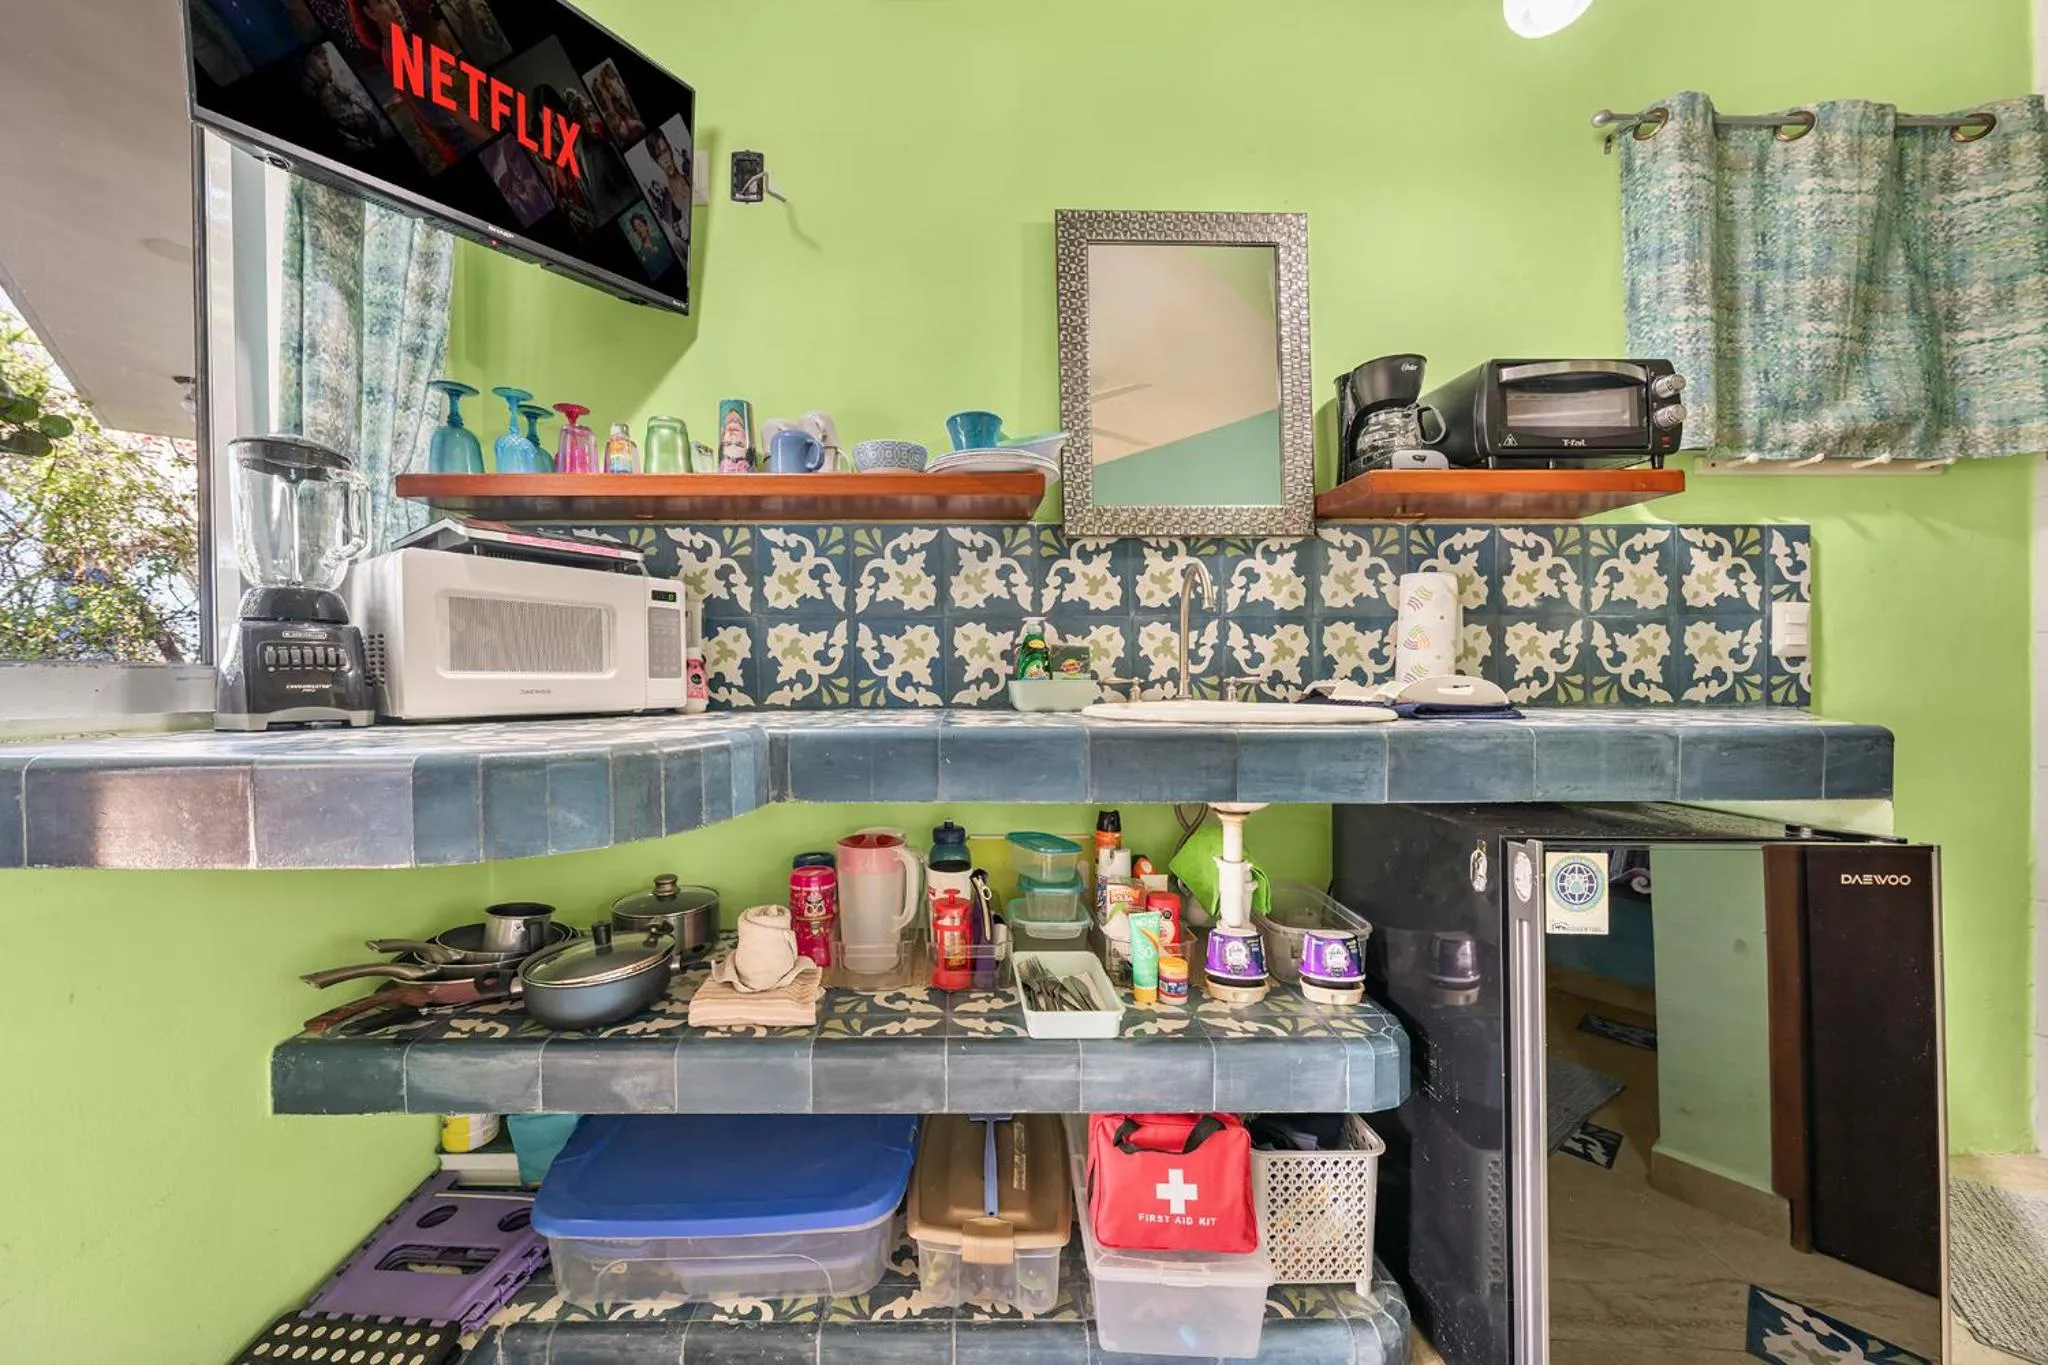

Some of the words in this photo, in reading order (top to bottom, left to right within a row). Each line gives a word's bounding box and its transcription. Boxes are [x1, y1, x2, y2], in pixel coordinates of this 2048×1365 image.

[391, 22, 581, 179] NETFLIX
[1841, 874, 1911, 885] DAEWOO
[1138, 1213, 1170, 1224] FIRST
[1174, 1216, 1194, 1226] AID
[1199, 1216, 1217, 1226] KIT
